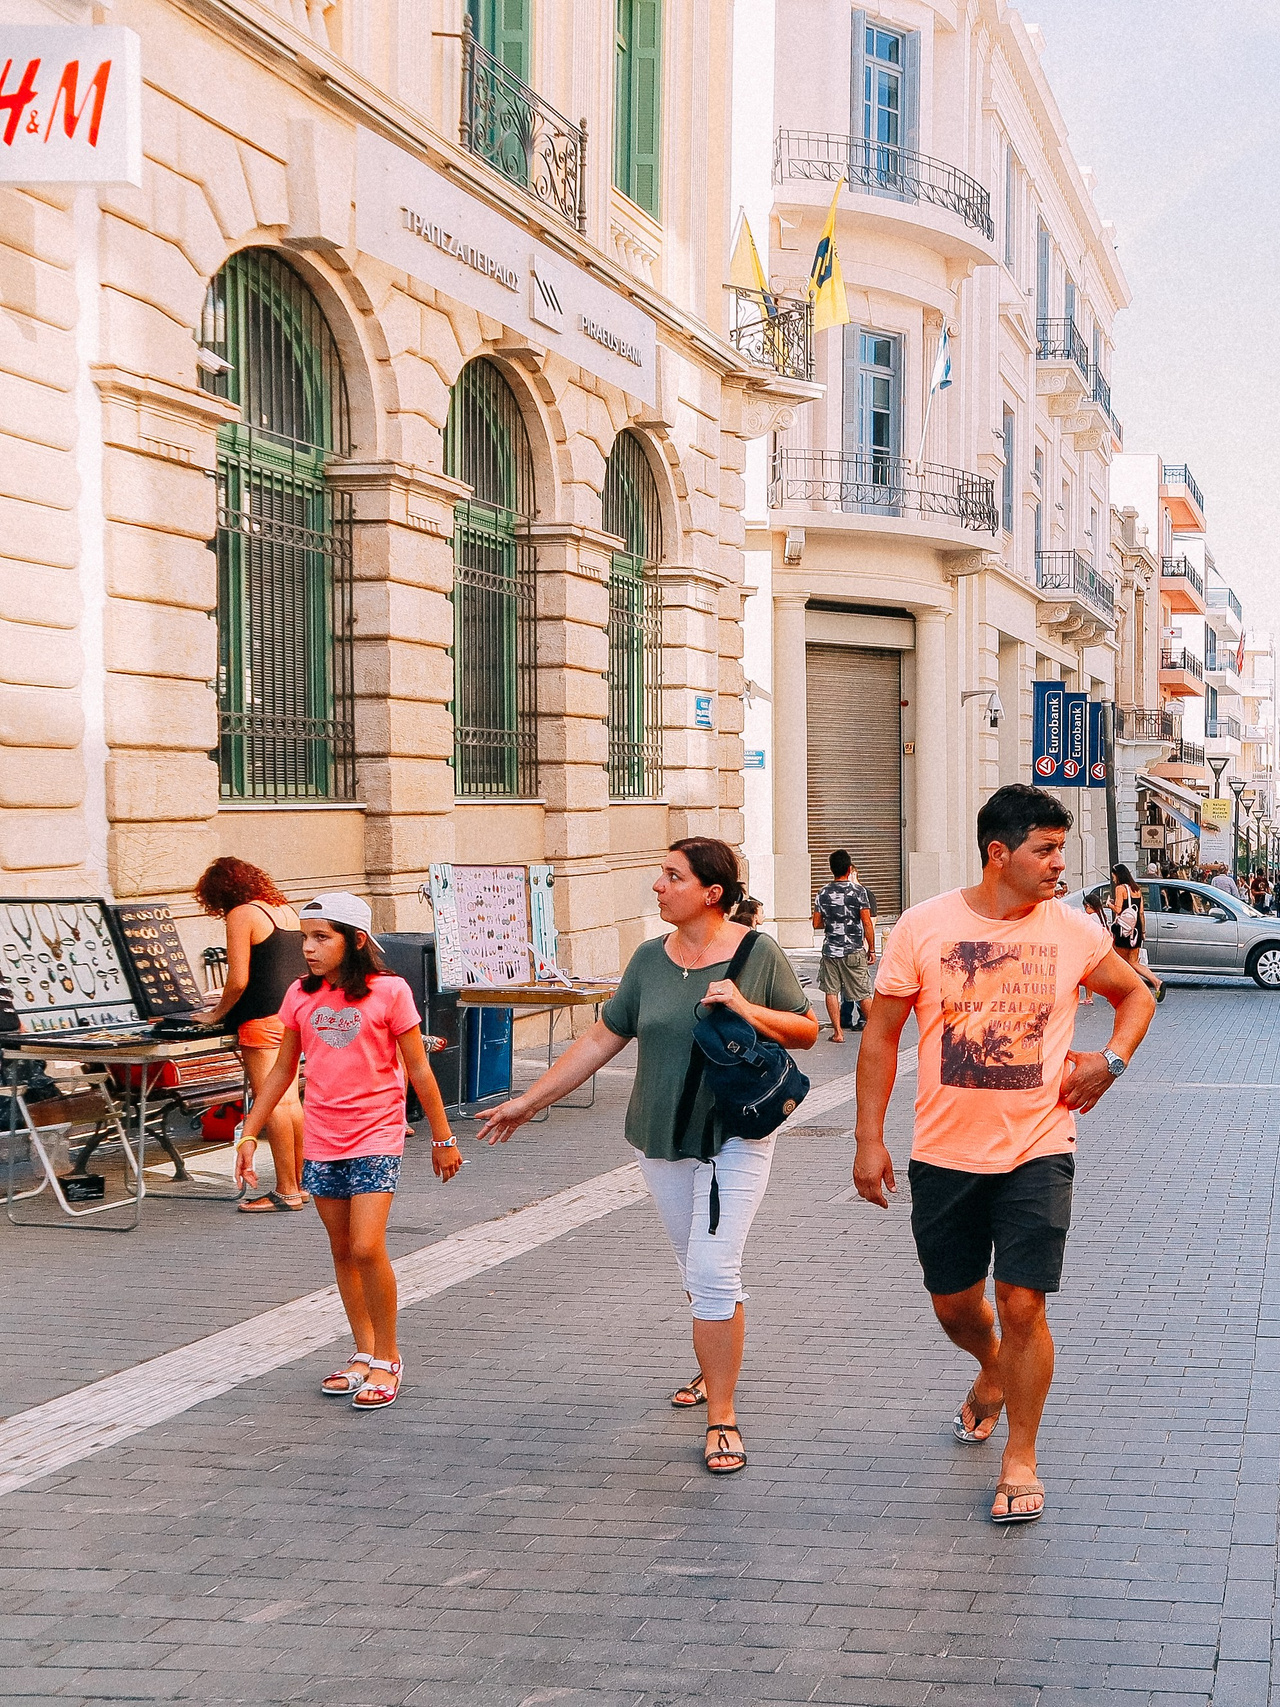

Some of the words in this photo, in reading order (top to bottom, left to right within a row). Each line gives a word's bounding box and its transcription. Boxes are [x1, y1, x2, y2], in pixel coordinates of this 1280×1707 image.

[0, 57, 112, 148] H&M
[578, 313, 620, 352] PIRAEUS
[620, 337, 644, 368] BANK
[1048, 697, 1059, 754] Eurobank
[1072, 707, 1082, 758] Eurobank
[1029, 944, 1058, 958] THE
[1021, 962, 1057, 977] WILD
[1001, 982, 1056, 995] NATURE
[954, 1001, 984, 1013] NEW
